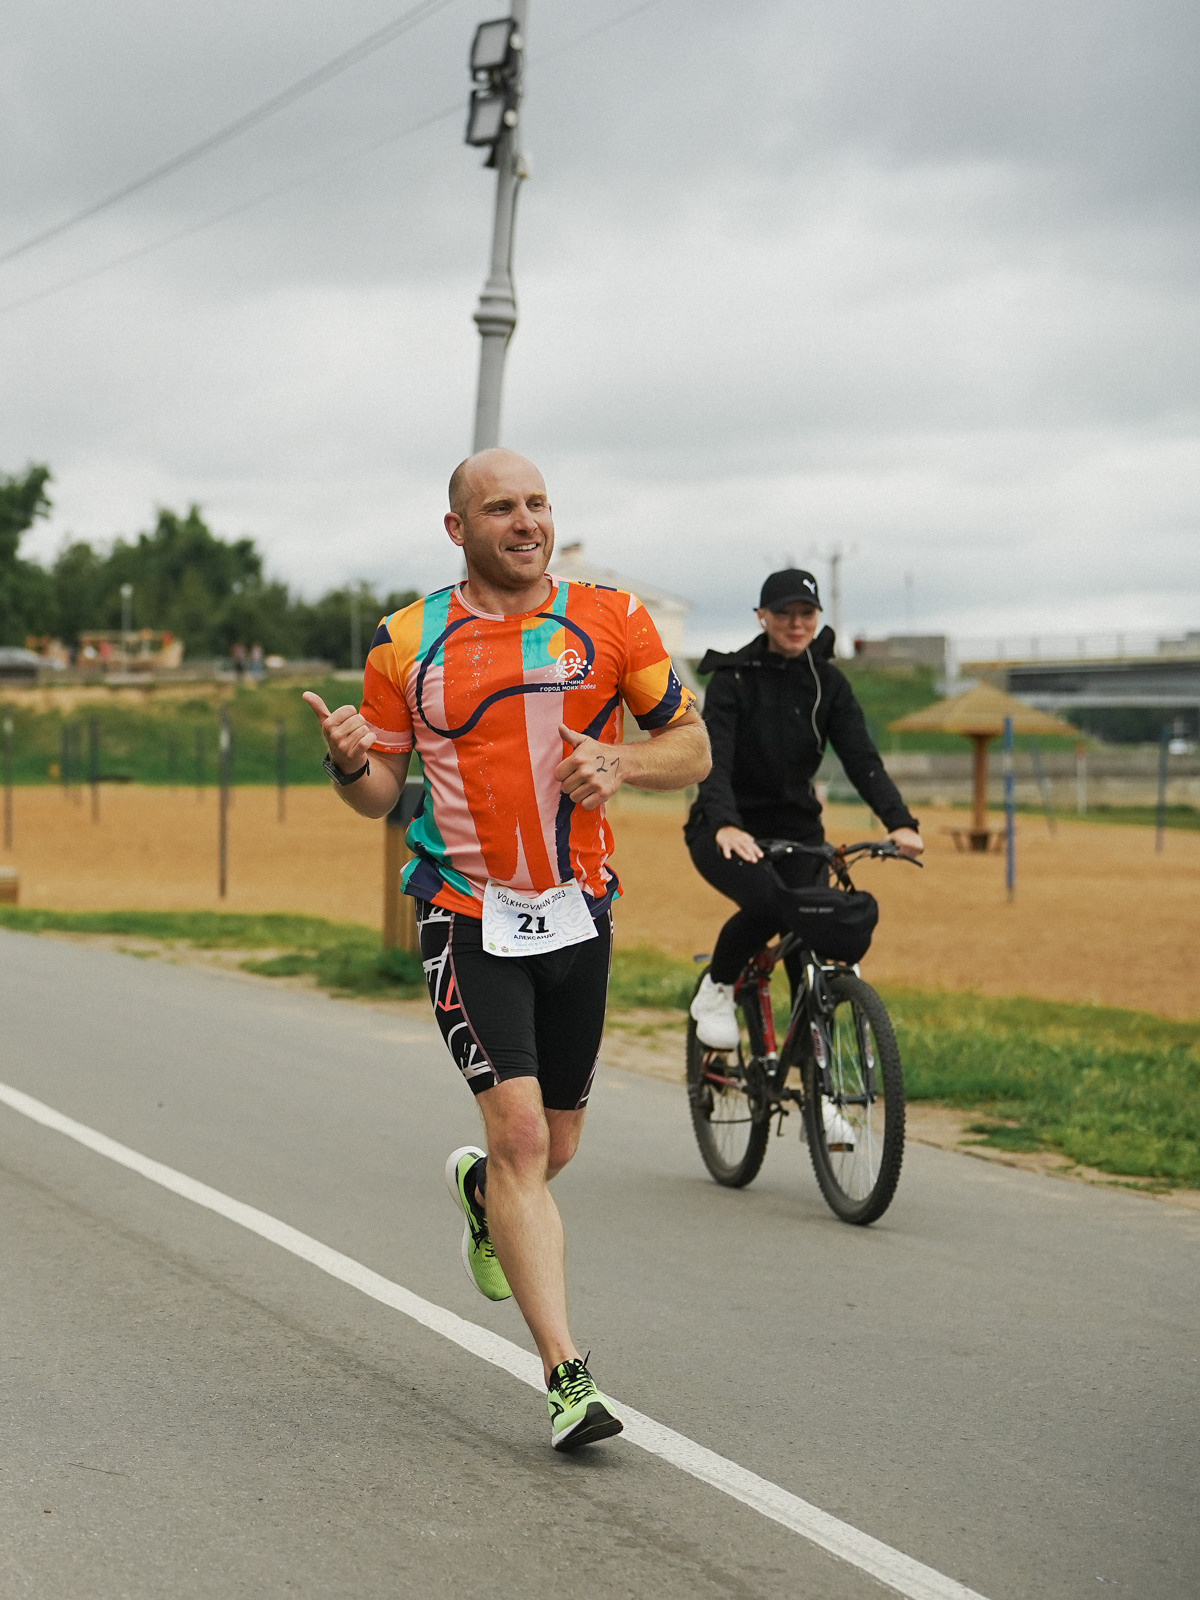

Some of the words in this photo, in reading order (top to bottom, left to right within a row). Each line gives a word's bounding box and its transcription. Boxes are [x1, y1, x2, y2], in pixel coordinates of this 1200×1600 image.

[596, 755, 620, 779] 21
[497, 891, 551, 910] VOLKHOVMAN
[551, 890, 566, 903] 2023
[517, 912, 549, 934] 21
